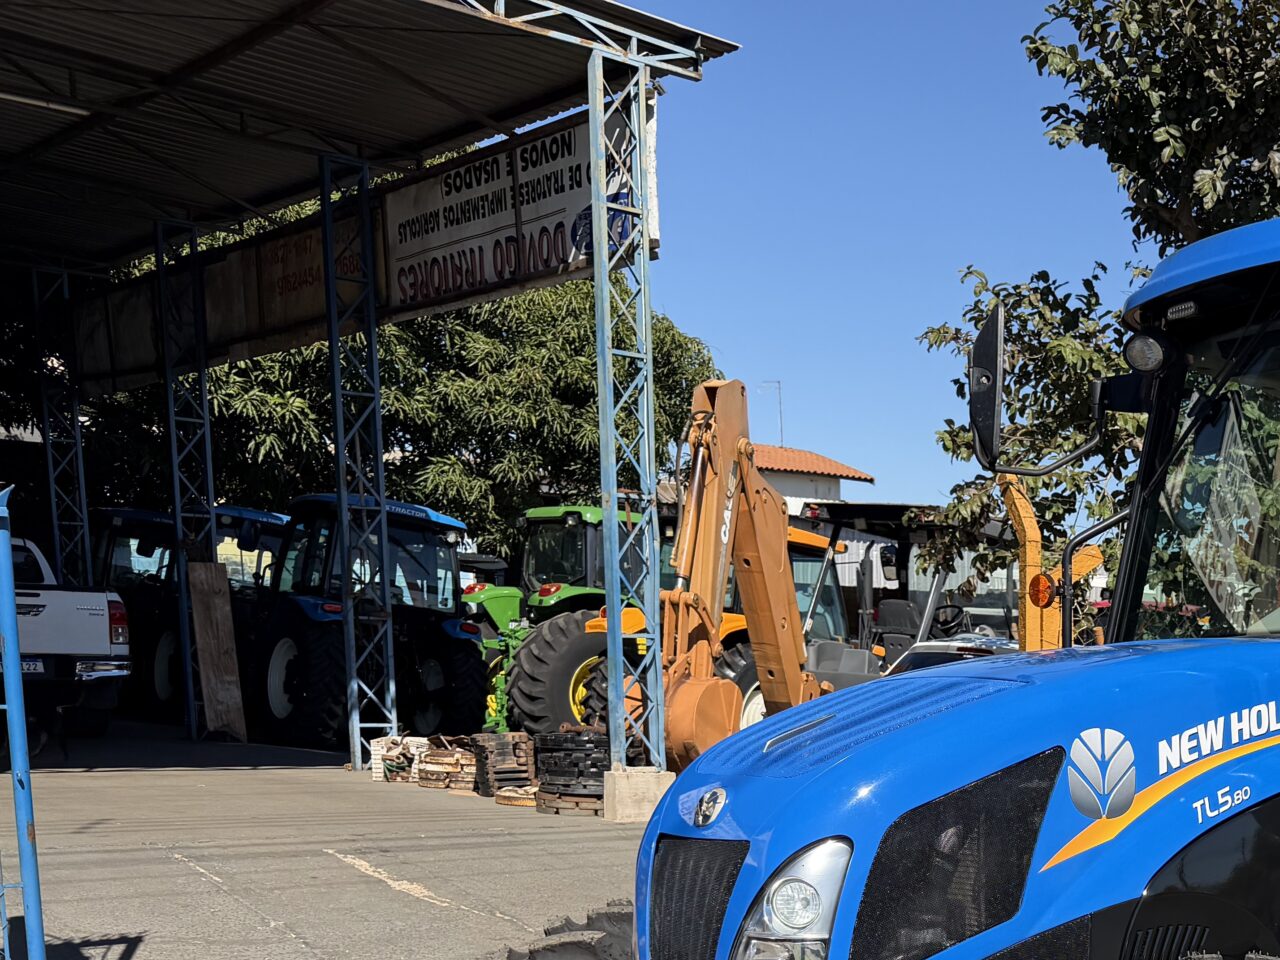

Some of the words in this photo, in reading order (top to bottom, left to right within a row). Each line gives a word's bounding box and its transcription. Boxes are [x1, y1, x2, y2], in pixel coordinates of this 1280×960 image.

[518, 168, 566, 206] TRATORES
[569, 163, 582, 191] DE
[443, 187, 507, 228] IMPLEMENTOS
[397, 245, 488, 304] TRATORES
[391, 506, 426, 518] TRACTOR
[1158, 716, 1225, 775] NEW
[1192, 785, 1251, 825] TL5.80
